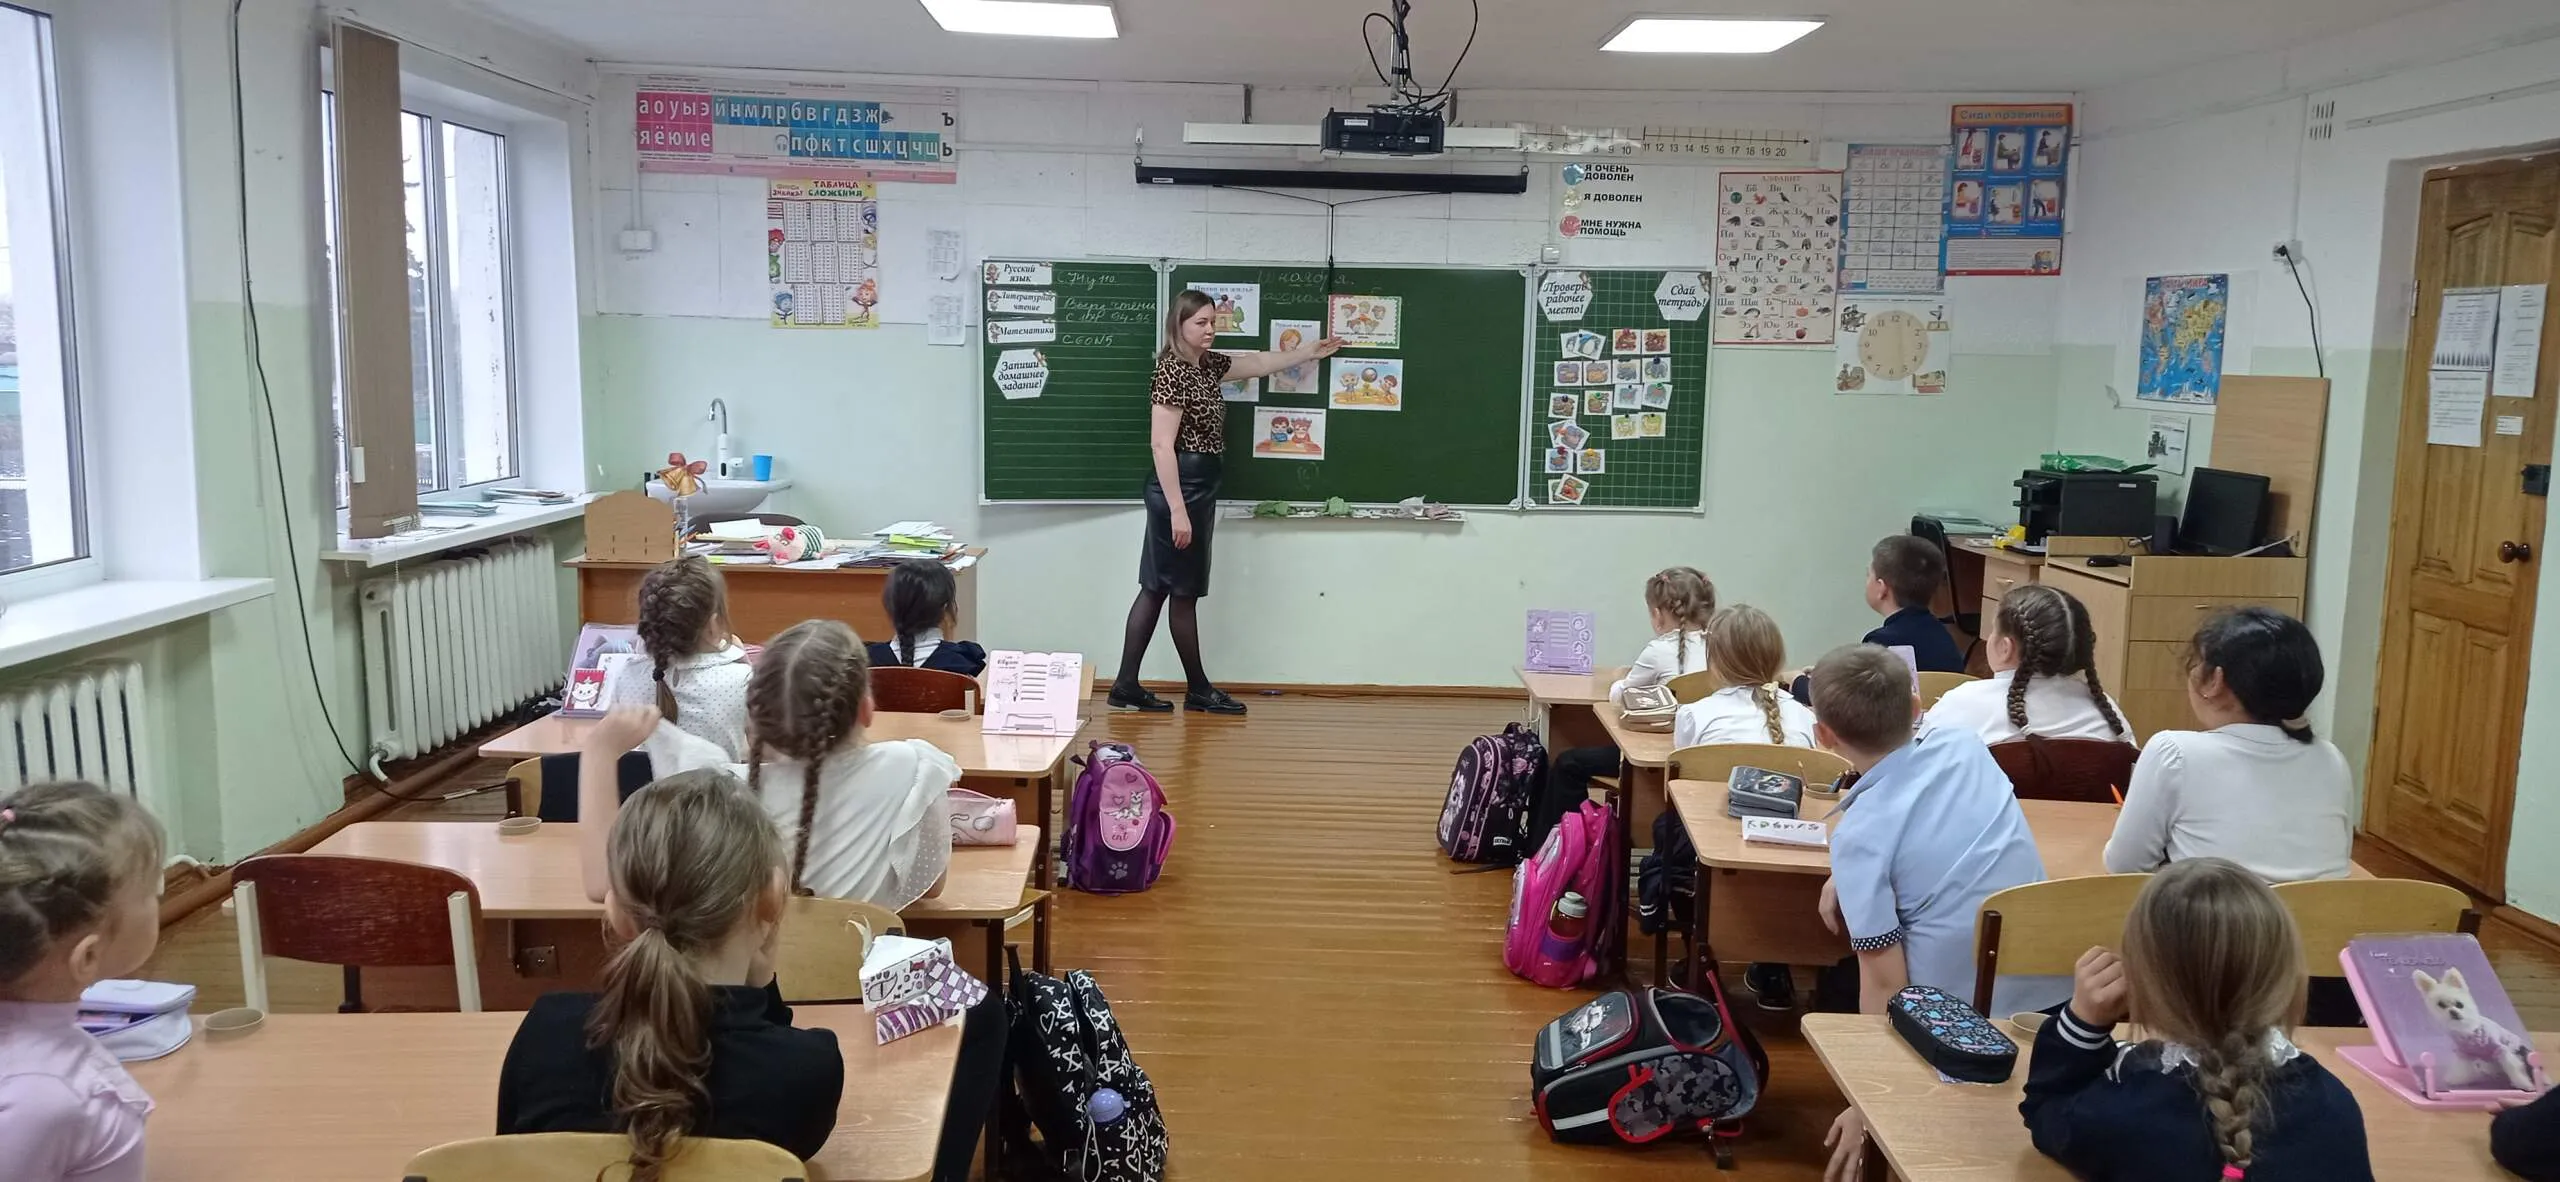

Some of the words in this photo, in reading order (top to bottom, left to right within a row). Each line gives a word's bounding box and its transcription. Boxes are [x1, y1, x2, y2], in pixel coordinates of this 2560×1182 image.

[1622, 146, 1631, 155] 10
[1643, 143, 1650, 151] 11
[1656, 144, 1664, 152] 12
[1670, 144, 1679, 152] 13
[1686, 144, 1694, 153] 14
[1701, 145, 1709, 153] 15
[1716, 146, 1725, 154] 16
[1732, 146, 1740, 155] 17
[1746, 147, 1755, 156] 18
[1762, 148, 1771, 156] 19
[1776, 148, 1787, 157] 20
[1595, 165, 1629, 173] ОЧЕНЬ
[1585, 173, 1634, 181] ДОВОЛЕН
[814, 181, 859, 189] ТАБЛИЦА
[1594, 194, 1642, 202] ДОВОЛЕН
[1606, 221, 1642, 229] НУЖНА
[1580, 228, 1626, 237] ПОМОЩЬ
[1004, 264, 1036, 275] Русский
[1671, 284, 1696, 295] Сдай
[1546, 292, 1585, 306] рабочее
[1659, 296, 1706, 310] тетрадь!
[1547, 304, 1584, 315] место!
[1002, 362, 1039, 371] Запиши
[999, 371, 1044, 380] домашнее
[1002, 380, 1042, 390] задание!
